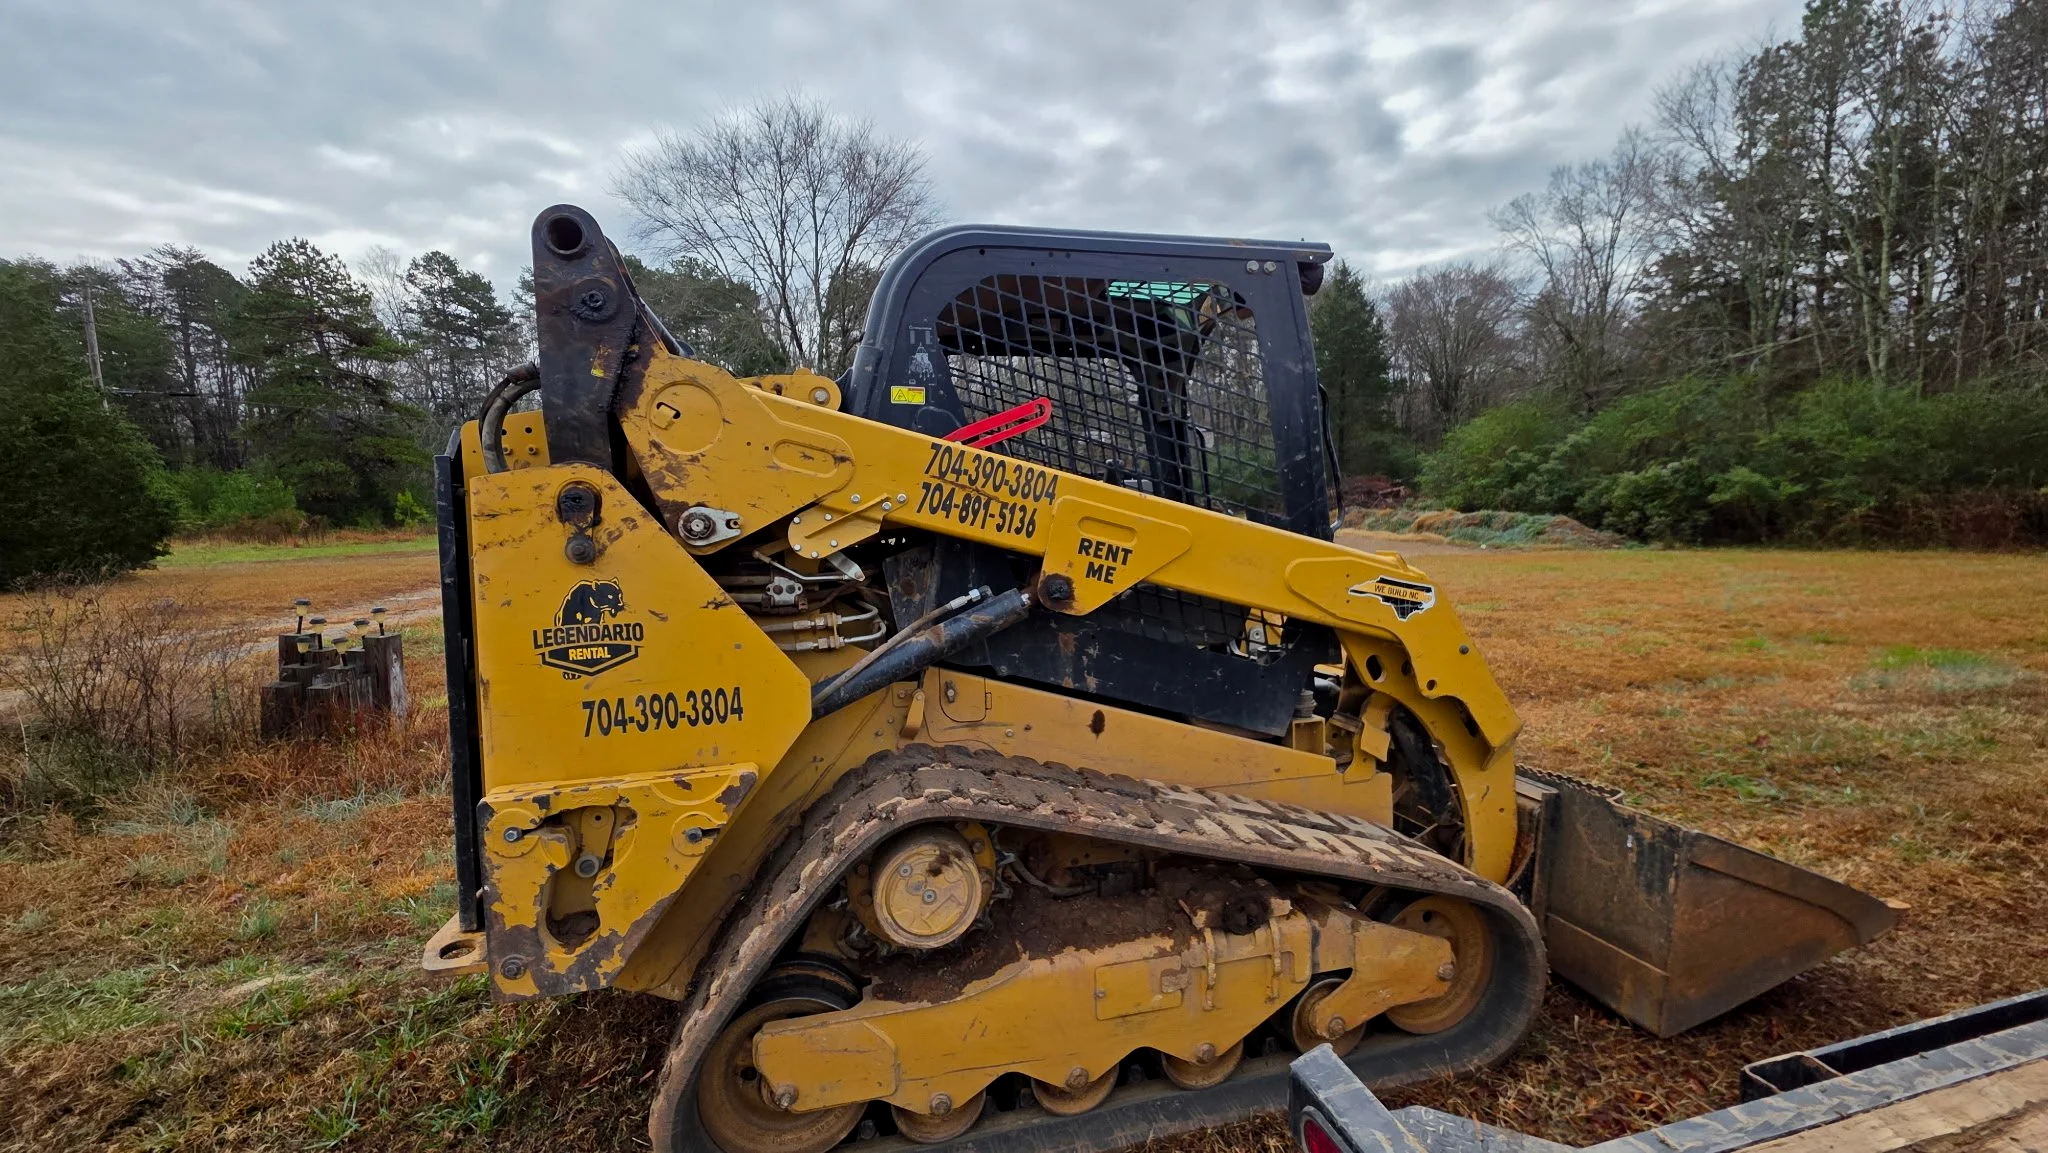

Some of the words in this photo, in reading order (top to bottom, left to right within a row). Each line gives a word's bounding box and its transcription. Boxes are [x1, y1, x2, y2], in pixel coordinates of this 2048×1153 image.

[924, 442, 1059, 505] 704-390-3804
[916, 482, 1037, 539] 704-891-5136
[1077, 537, 1133, 566] RENT
[1085, 561, 1117, 584] ME
[1374, 584, 1386, 594] WE
[1387, 588, 1408, 598] BUILD
[1408, 592, 1419, 600] NC
[532, 622, 645, 650] LEGENDARIO
[568, 647, 611, 661] RENTAL
[582, 686, 744, 738] 704-390-3804
